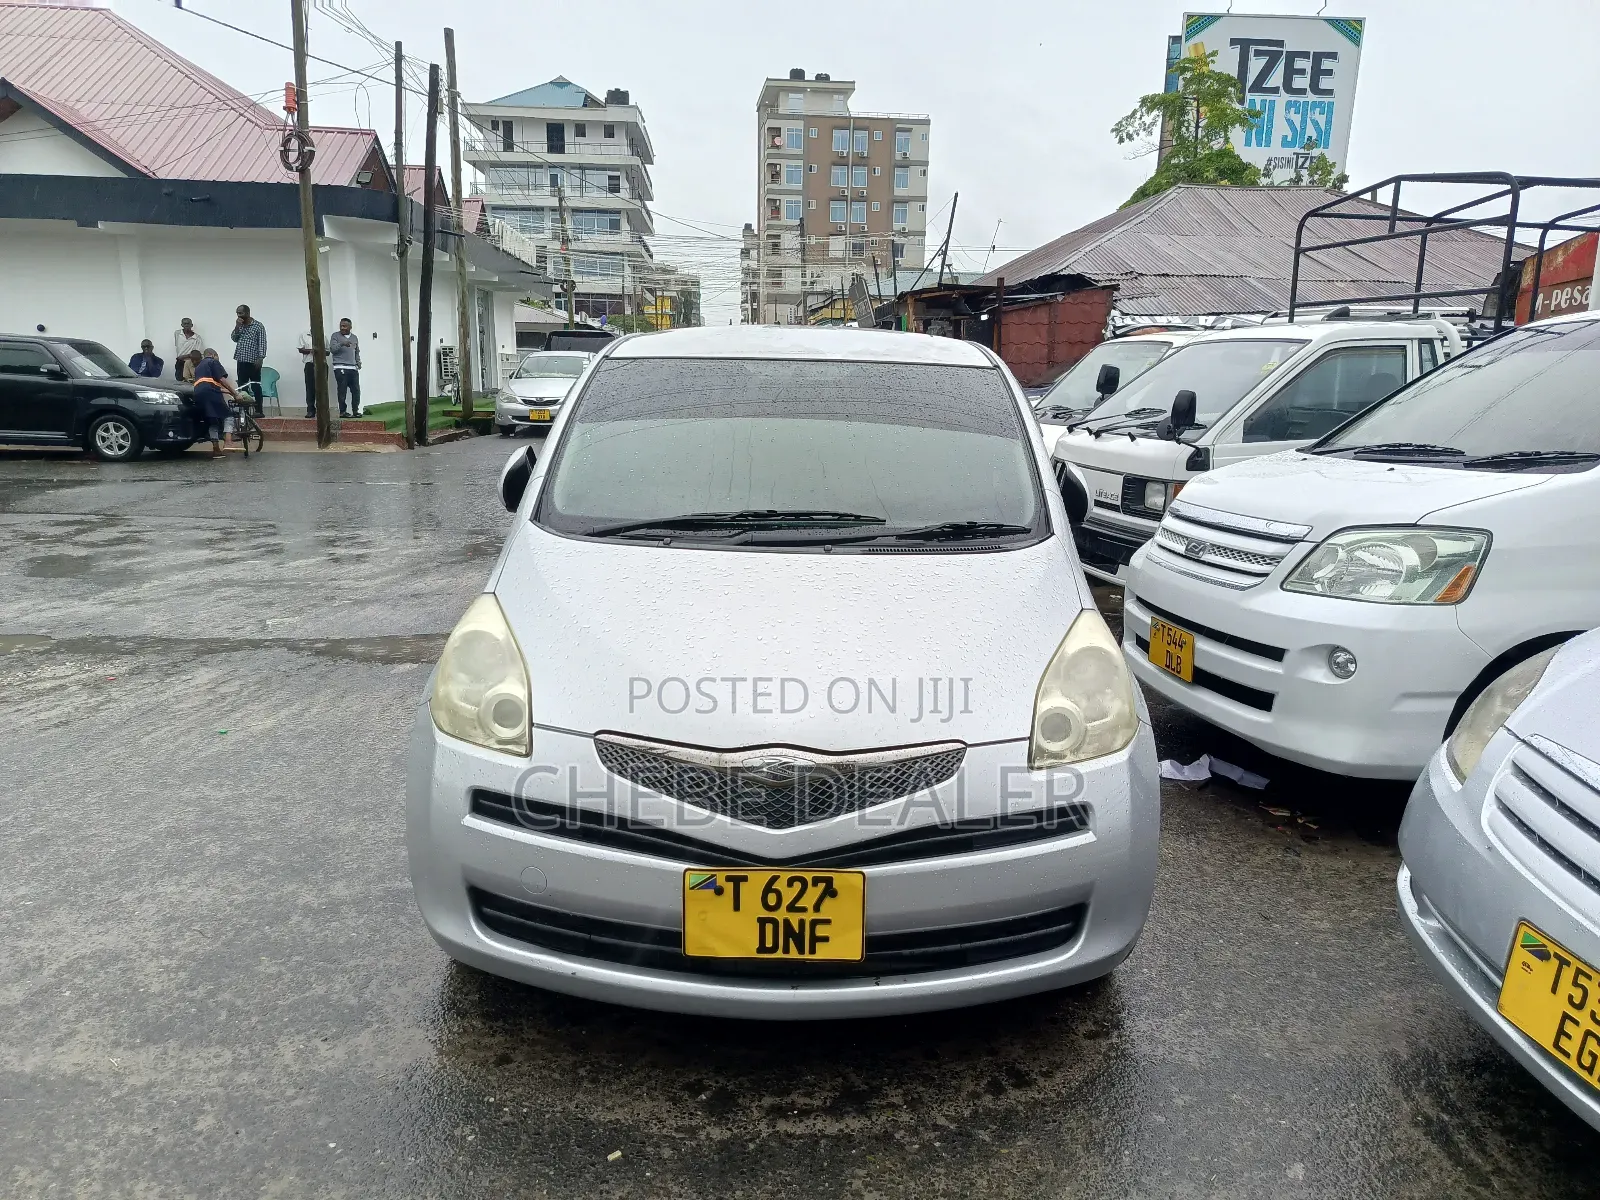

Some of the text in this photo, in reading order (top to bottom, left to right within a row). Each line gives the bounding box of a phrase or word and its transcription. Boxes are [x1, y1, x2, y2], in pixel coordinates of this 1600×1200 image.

[1229, 38, 1339, 106] TZEE
[1244, 98, 1334, 149] NI SISI
[1165, 649, 1182, 675] DLB
[756, 916, 833, 955] DNF
